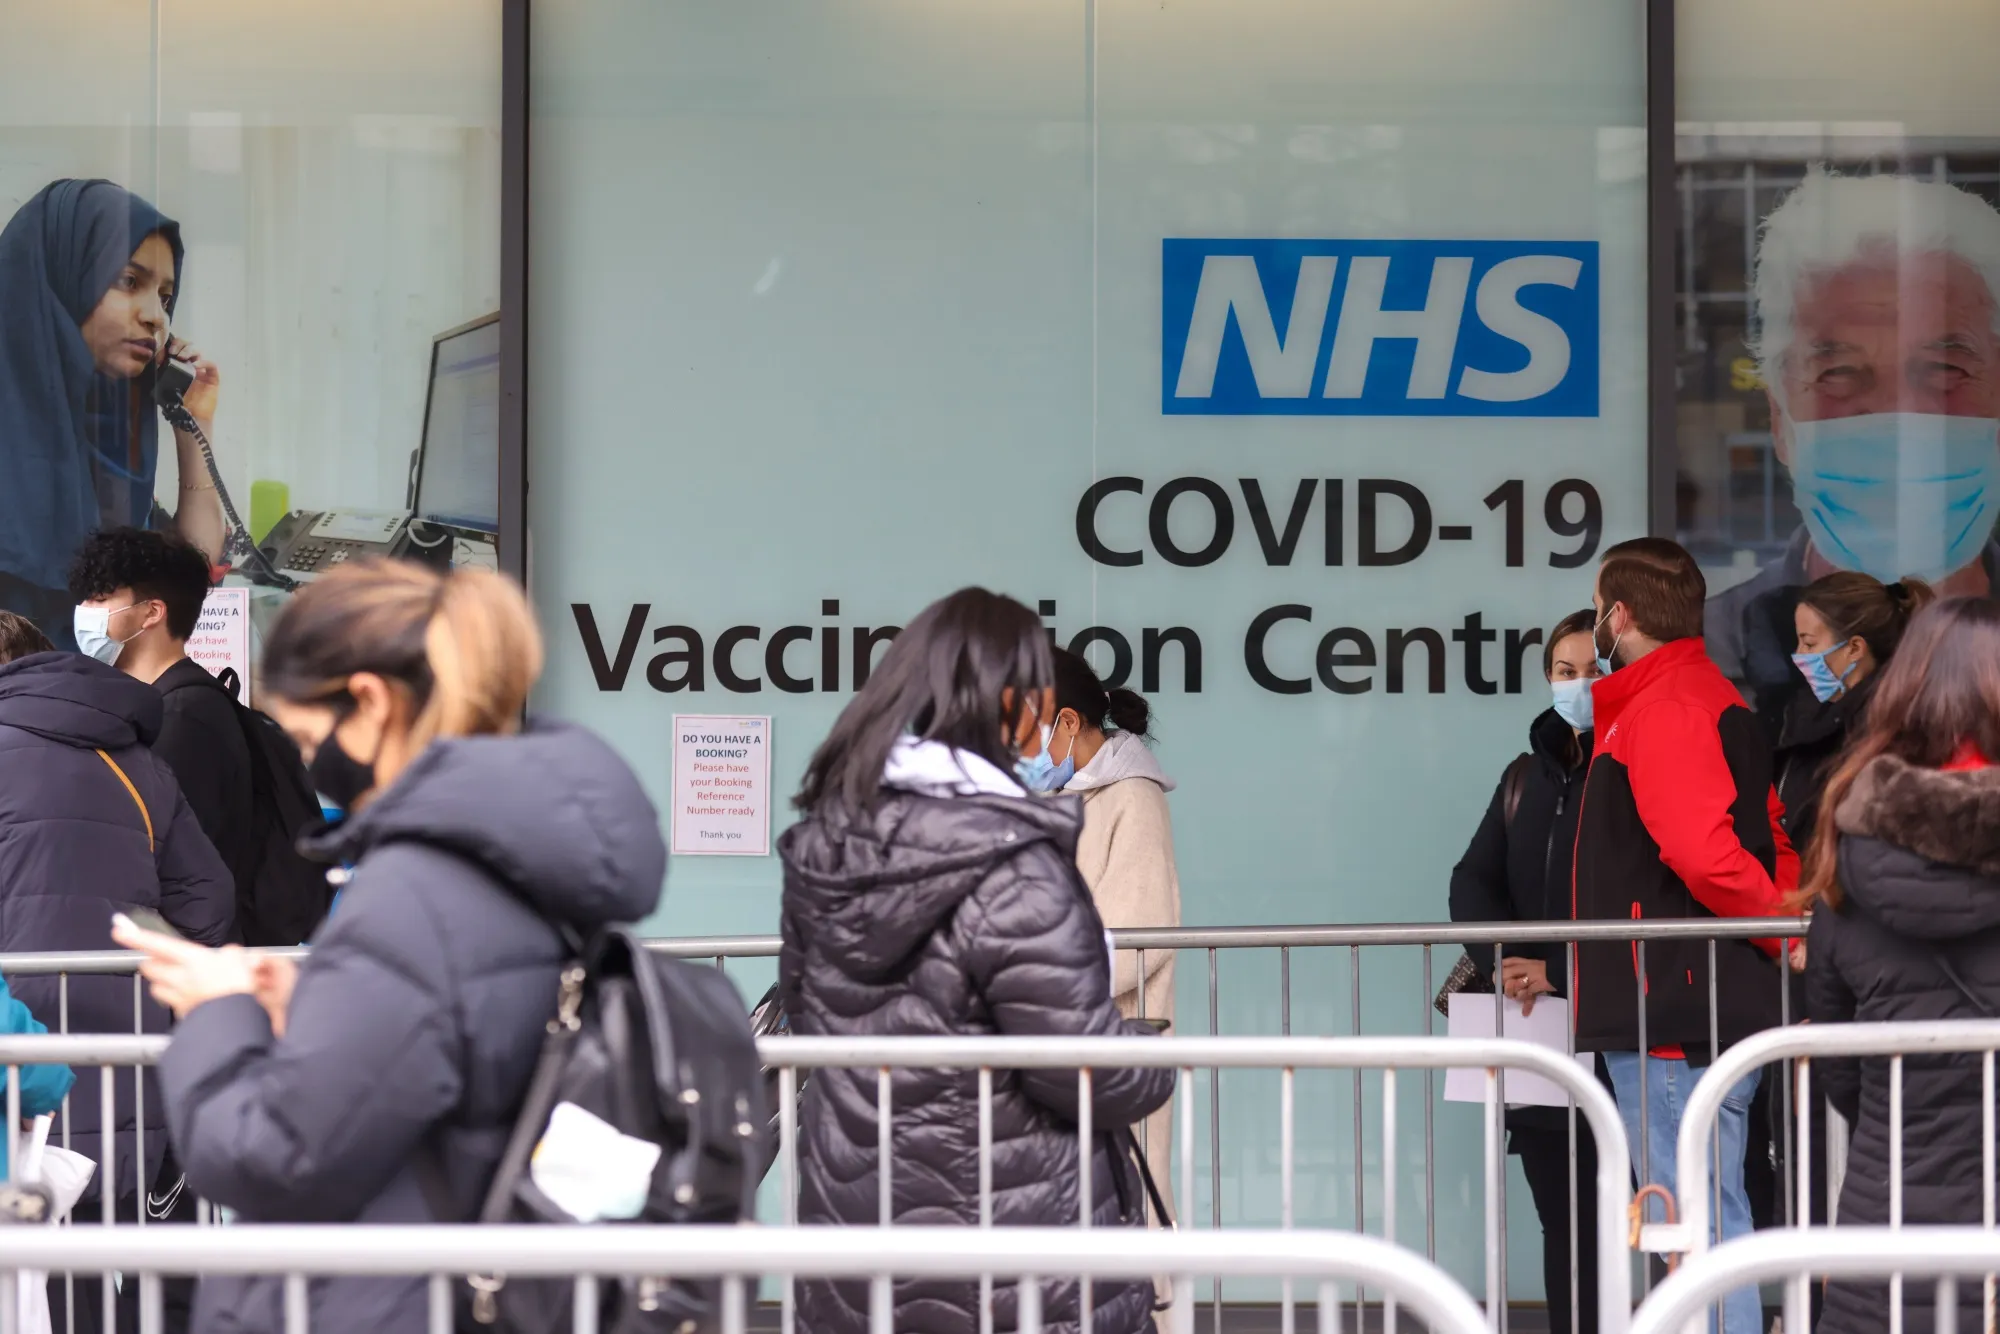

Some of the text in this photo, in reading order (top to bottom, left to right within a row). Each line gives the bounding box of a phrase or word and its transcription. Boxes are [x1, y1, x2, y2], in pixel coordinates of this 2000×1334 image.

[1174, 254, 1584, 402] NHS
[1075, 475, 1603, 569] COVID-19
[203, 608, 239, 616] HAVE A
[206, 635, 228, 644] have
[571, 599, 1203, 694] Vaccinon
[194, 651, 231, 660] Booking
[683, 735, 761, 744] DO YOU HAVE A
[696, 749, 747, 758] BOOKING?
[694, 763, 749, 772] Please have
[690, 778, 752, 788] your Booking
[698, 792, 744, 800] Reference
[687, 806, 755, 817] Number ready
